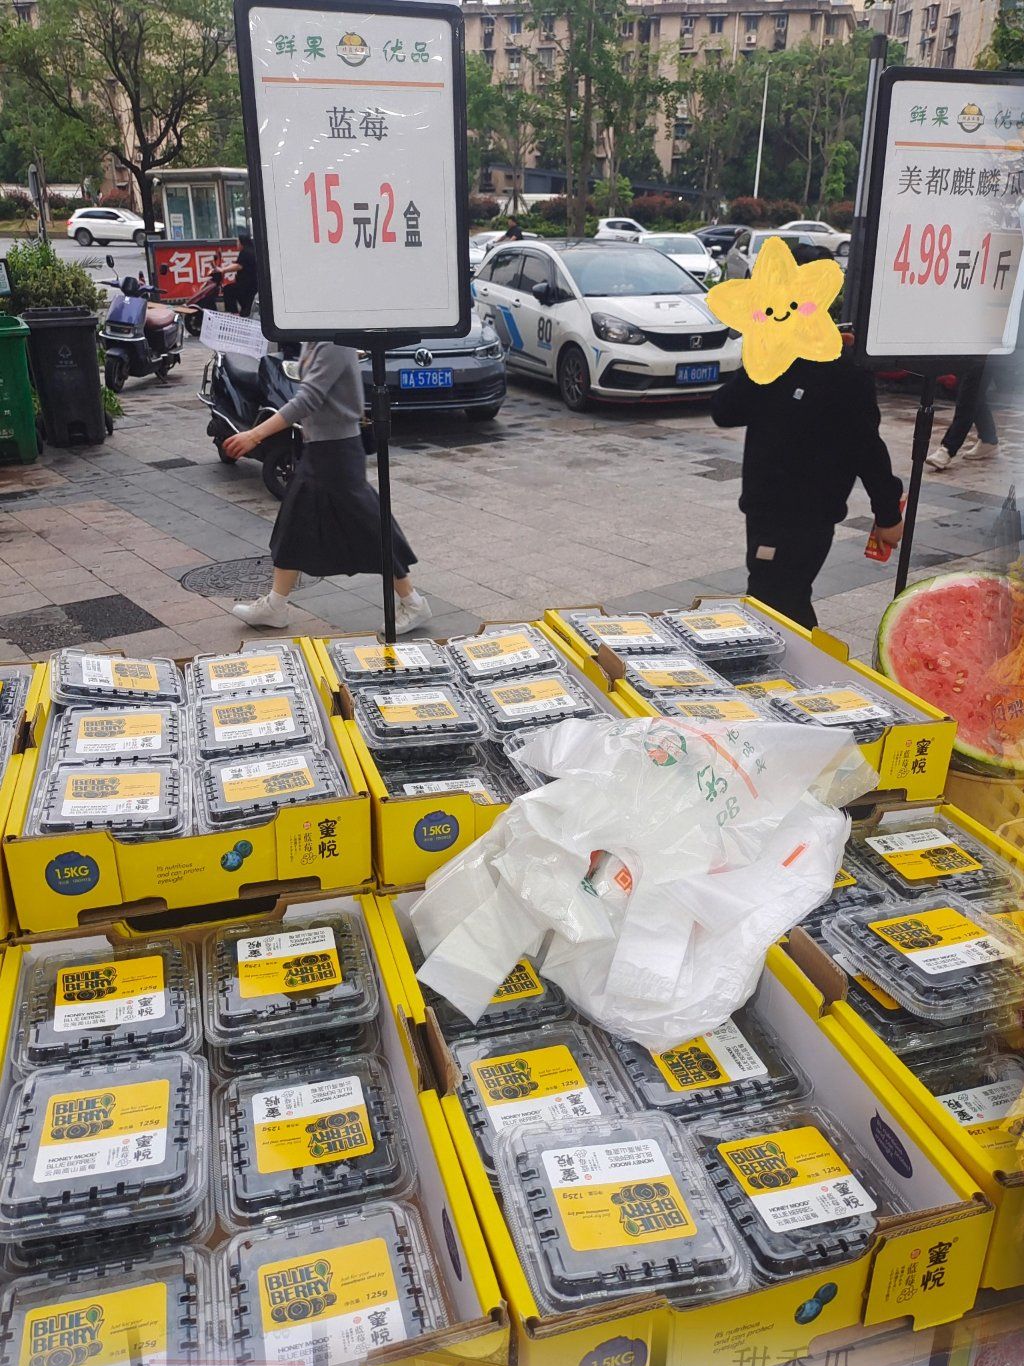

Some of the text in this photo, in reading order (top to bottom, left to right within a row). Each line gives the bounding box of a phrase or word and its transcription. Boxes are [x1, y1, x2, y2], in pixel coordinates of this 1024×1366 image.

[274, 34, 430, 63] 鲜果 优品
[325, 106, 389, 141] 蓝莓
[910, 105, 949, 127] 鲜果
[897, 165, 1024, 197] 美都麒麟瓜
[537, 316, 552, 343] 80
[911, 738, 931, 774] 蜜悦
[317, 818, 340, 860] 蜜悦
[63, 969, 103, 983] BLUE
[64, 978, 113, 992] BERRY
[480, 1063, 516, 1079] BLUE
[485, 1070, 532, 1090] BERRY
[560, 1079, 579, 1088] 125g
[54, 1097, 100, 1116] BLUE
[54, 1108, 111, 1127] BERRY
[139, 1119, 160, 1127] 125g
[311, 1121, 362, 1144] BERRY
[324, 1133, 368, 1152] BLUE
[48, 1155, 72, 1163] HONEY
[609, 1157, 655, 1168] HONEY MOOD
[730, 1144, 767, 1165] BLUE
[554, 1153, 579, 1182] 蜜悦
[741, 1155, 788, 1176] BERRY
[822, 1165, 841, 1175] 125g
[768, 1200, 809, 1212] HONEY MOOD
[832, 1182, 864, 1210] 蜜悦
[621, 1197, 676, 1218] BERRY
[638, 1211, 686, 1232] BLUE
[920, 1240, 953, 1291] 蜜悦
[267, 1267, 314, 1291] BLUE
[270, 1280, 330, 1305] BERRY
[366, 1290, 388, 1300] 125g
[33, 1312, 85, 1338] BLUE
[368, 1311, 393, 1346] 蜜悦
[33, 1325, 98, 1354] BERRY
[132, 1340, 157, 1350] 125g
[277, 1336, 330, 1353] HONEY MOOD
